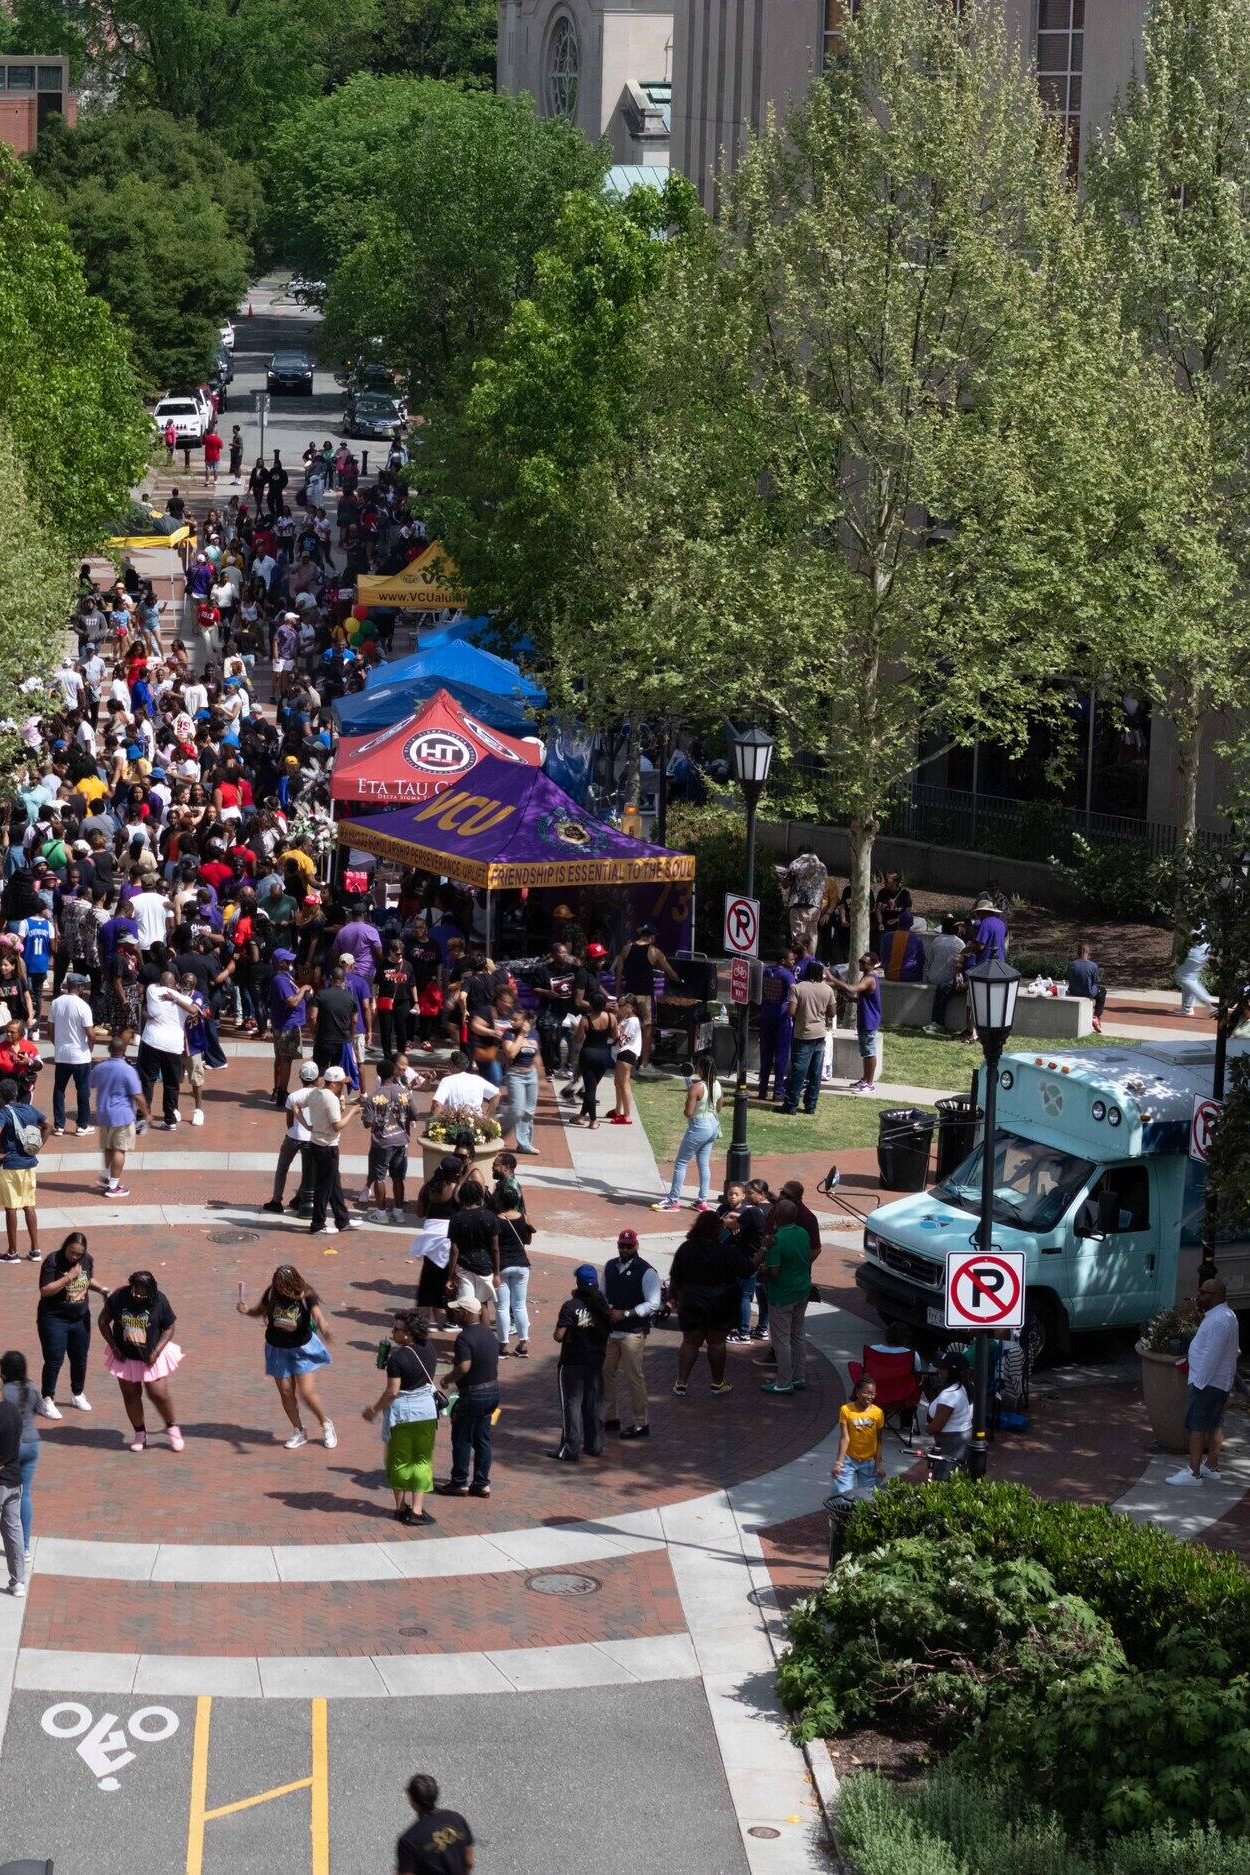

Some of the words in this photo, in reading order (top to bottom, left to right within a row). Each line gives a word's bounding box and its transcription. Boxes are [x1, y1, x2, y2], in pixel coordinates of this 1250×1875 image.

[420, 573, 448, 585] VC
[358, 778, 388, 794] ETA
[394, 780, 428, 795] TAU
[413, 789, 517, 836] VCU
[412, 848, 461, 874] PERSEVERANCE
[462, 863, 486, 884] UPLIFT
[491, 864, 554, 886] FRIENDSHIP
[555, 864, 564, 882] IS
[567, 863, 625, 882] ESSENTIAL
[627, 863, 640, 880] TO
[642, 860, 663, 879] THE
[664, 859, 692, 877] SOUL
[736, 908, 750, 938] P
[34, 937, 43, 955] 11
[733, 980, 747, 990] WRONG
[735, 989, 744, 998] WAY
[972, 1268, 1005, 1308] P
